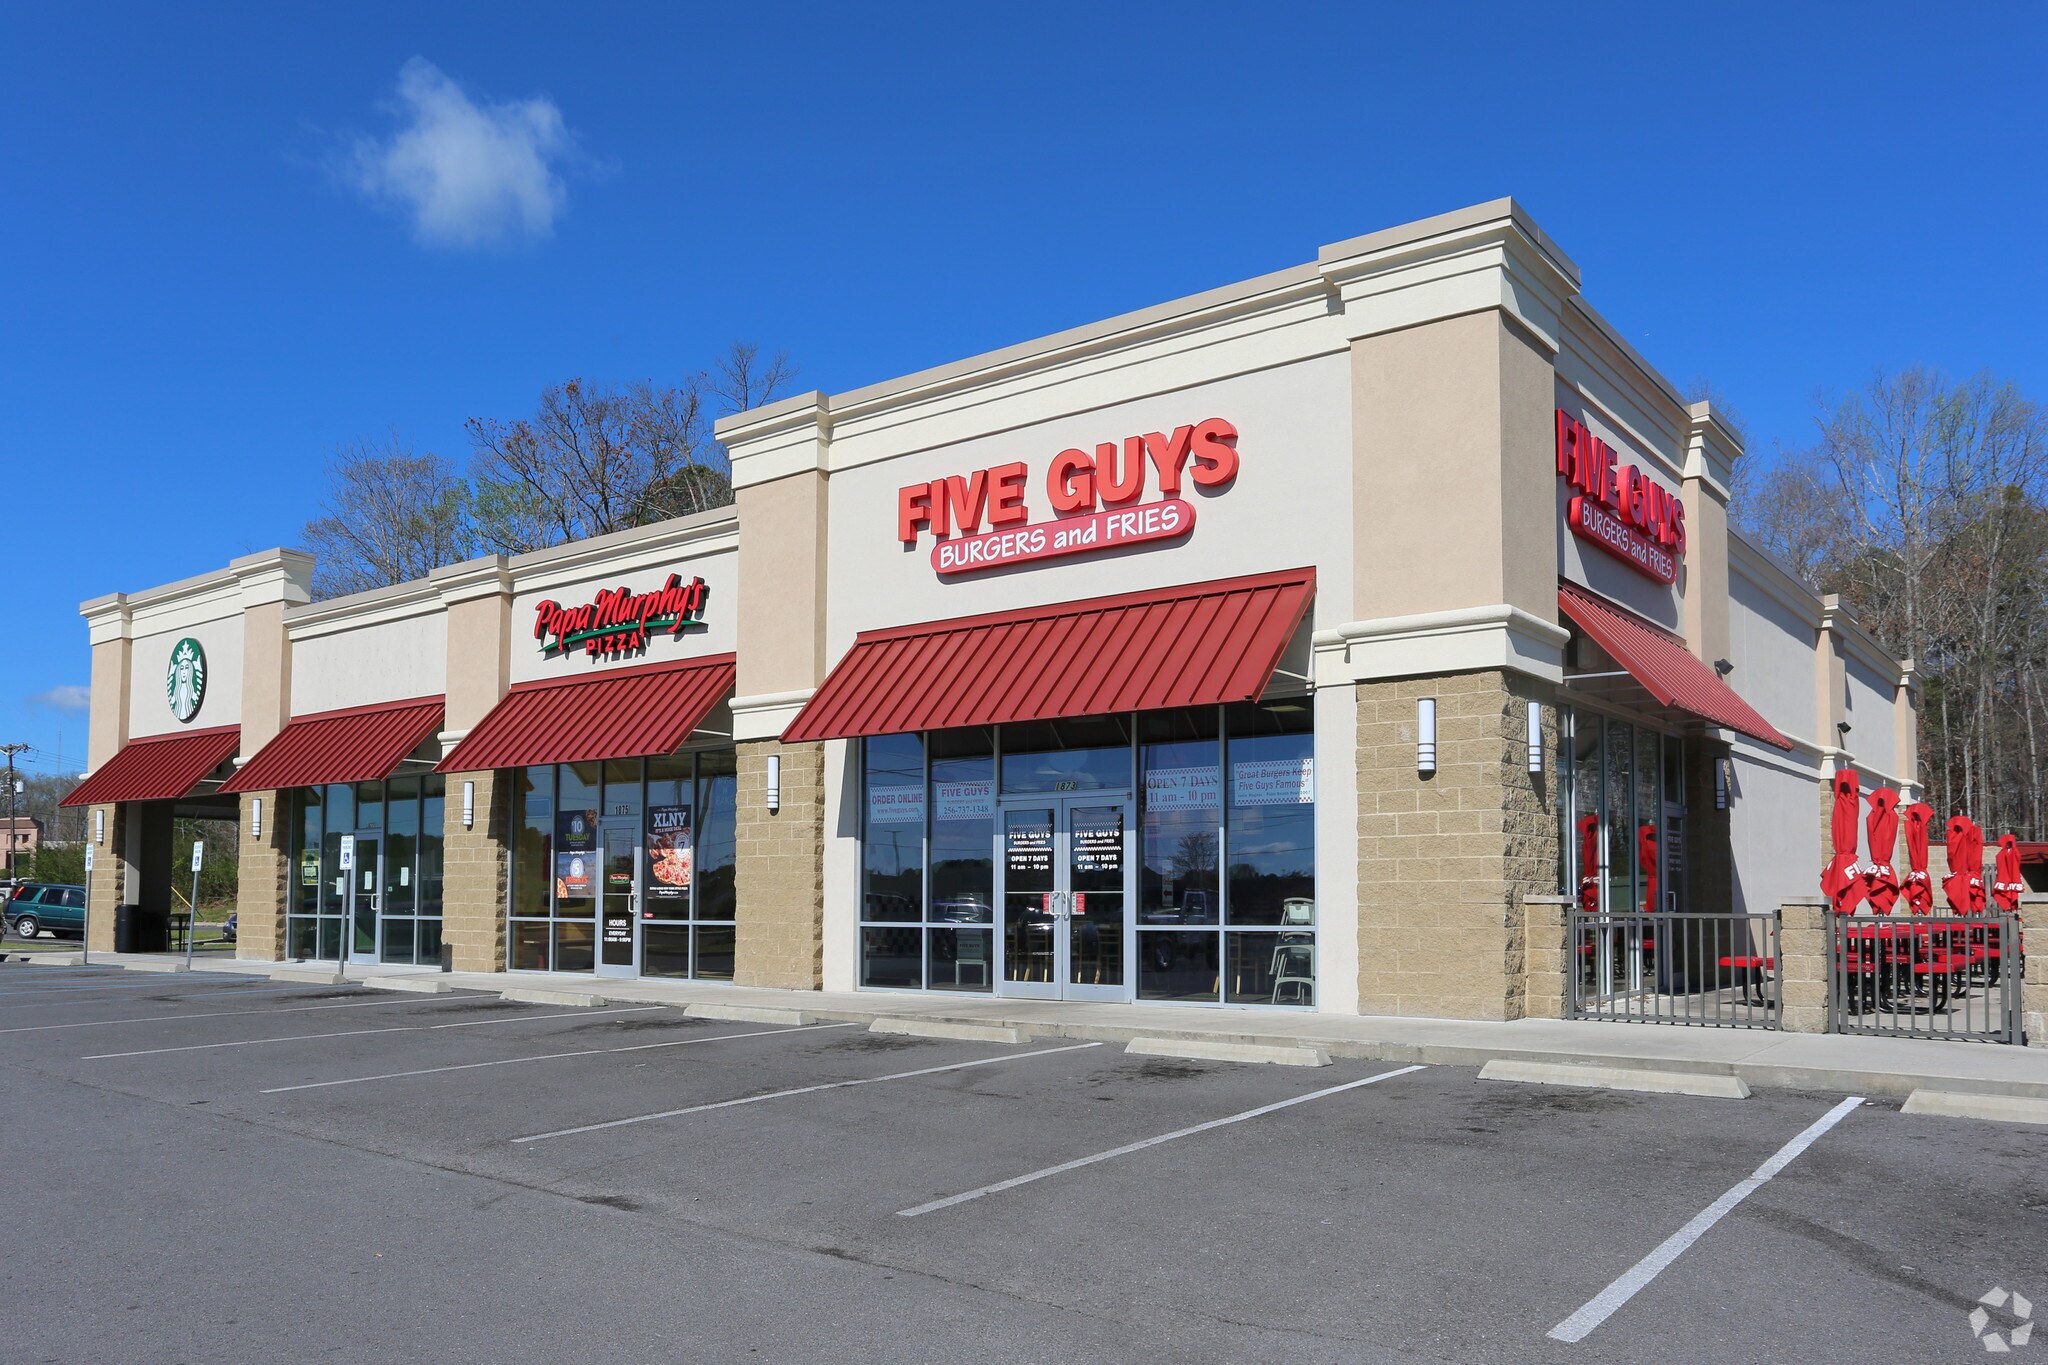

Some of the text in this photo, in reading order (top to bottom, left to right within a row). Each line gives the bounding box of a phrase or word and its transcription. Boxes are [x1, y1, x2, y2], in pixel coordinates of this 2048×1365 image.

[898, 418, 1239, 543] FIVE GUYS
[1557, 408, 1686, 555] FIVE GUYS
[940, 505, 1180, 569] BURGERS and FRIES
[1583, 503, 1672, 579] BURGERS and FRIES
[534, 573, 704, 651] Papa Murphy's
[586, 631, 640, 655] PIZZA
[1261, 769, 1290, 779] Burgers
[1292, 767, 1312, 777] Keep
[1056, 781, 1077, 791] 1873
[1148, 775, 1218, 789] OPEN 7 DAYS
[1239, 781, 1253, 790] Five
[1256, 780, 1274, 791] Guys
[941, 786, 990, 797] FIVE GUYS
[1149, 792, 1159, 803] 11
[1162, 793, 1177, 802] am
[1188, 790, 1197, 801] 10
[1200, 791, 1216, 803] pm
[871, 793, 923, 805] ORDER ONLINE
[944, 806, 988, 815] 256-737-1348
[653, 812, 686, 827] XLNY
[1009, 830, 1051, 839] FIVE GUYS
[1096, 829, 1120, 837] GUYS
[608, 919, 626, 927] HOURS
